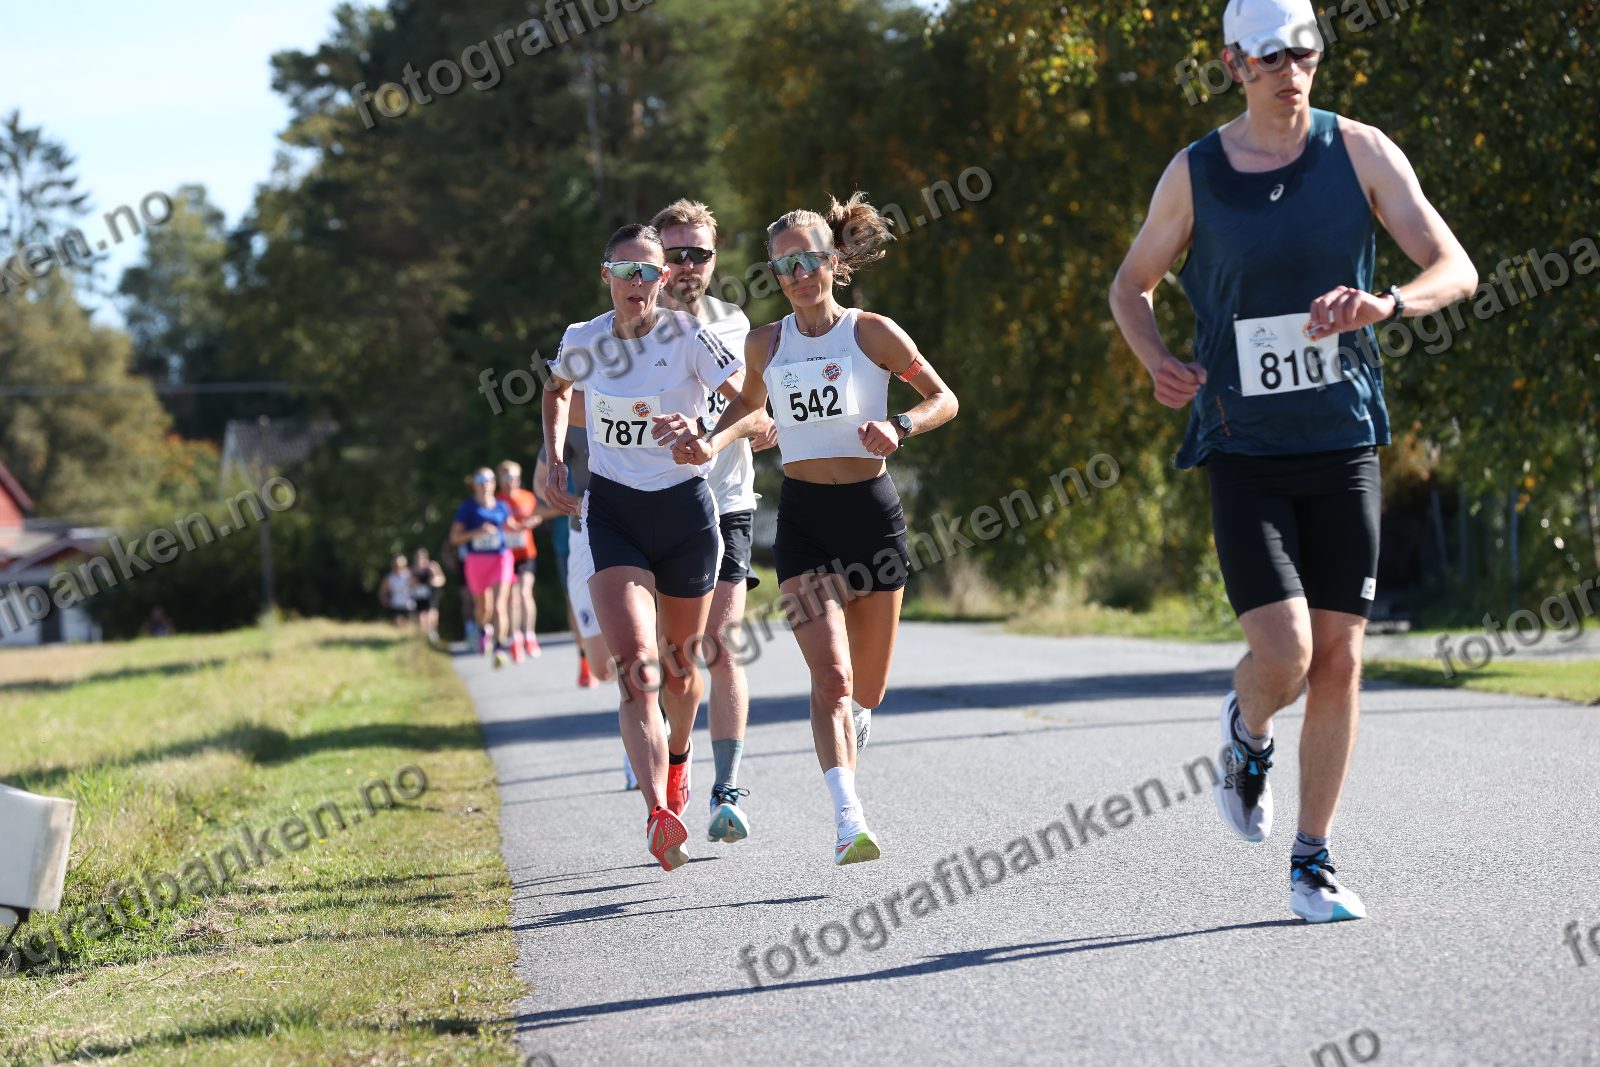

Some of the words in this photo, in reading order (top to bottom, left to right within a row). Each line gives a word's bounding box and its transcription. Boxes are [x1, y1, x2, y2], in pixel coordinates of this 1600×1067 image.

[1260, 346, 1324, 390] 810
[789, 385, 843, 421] 542
[600, 417, 648, 446] 787
